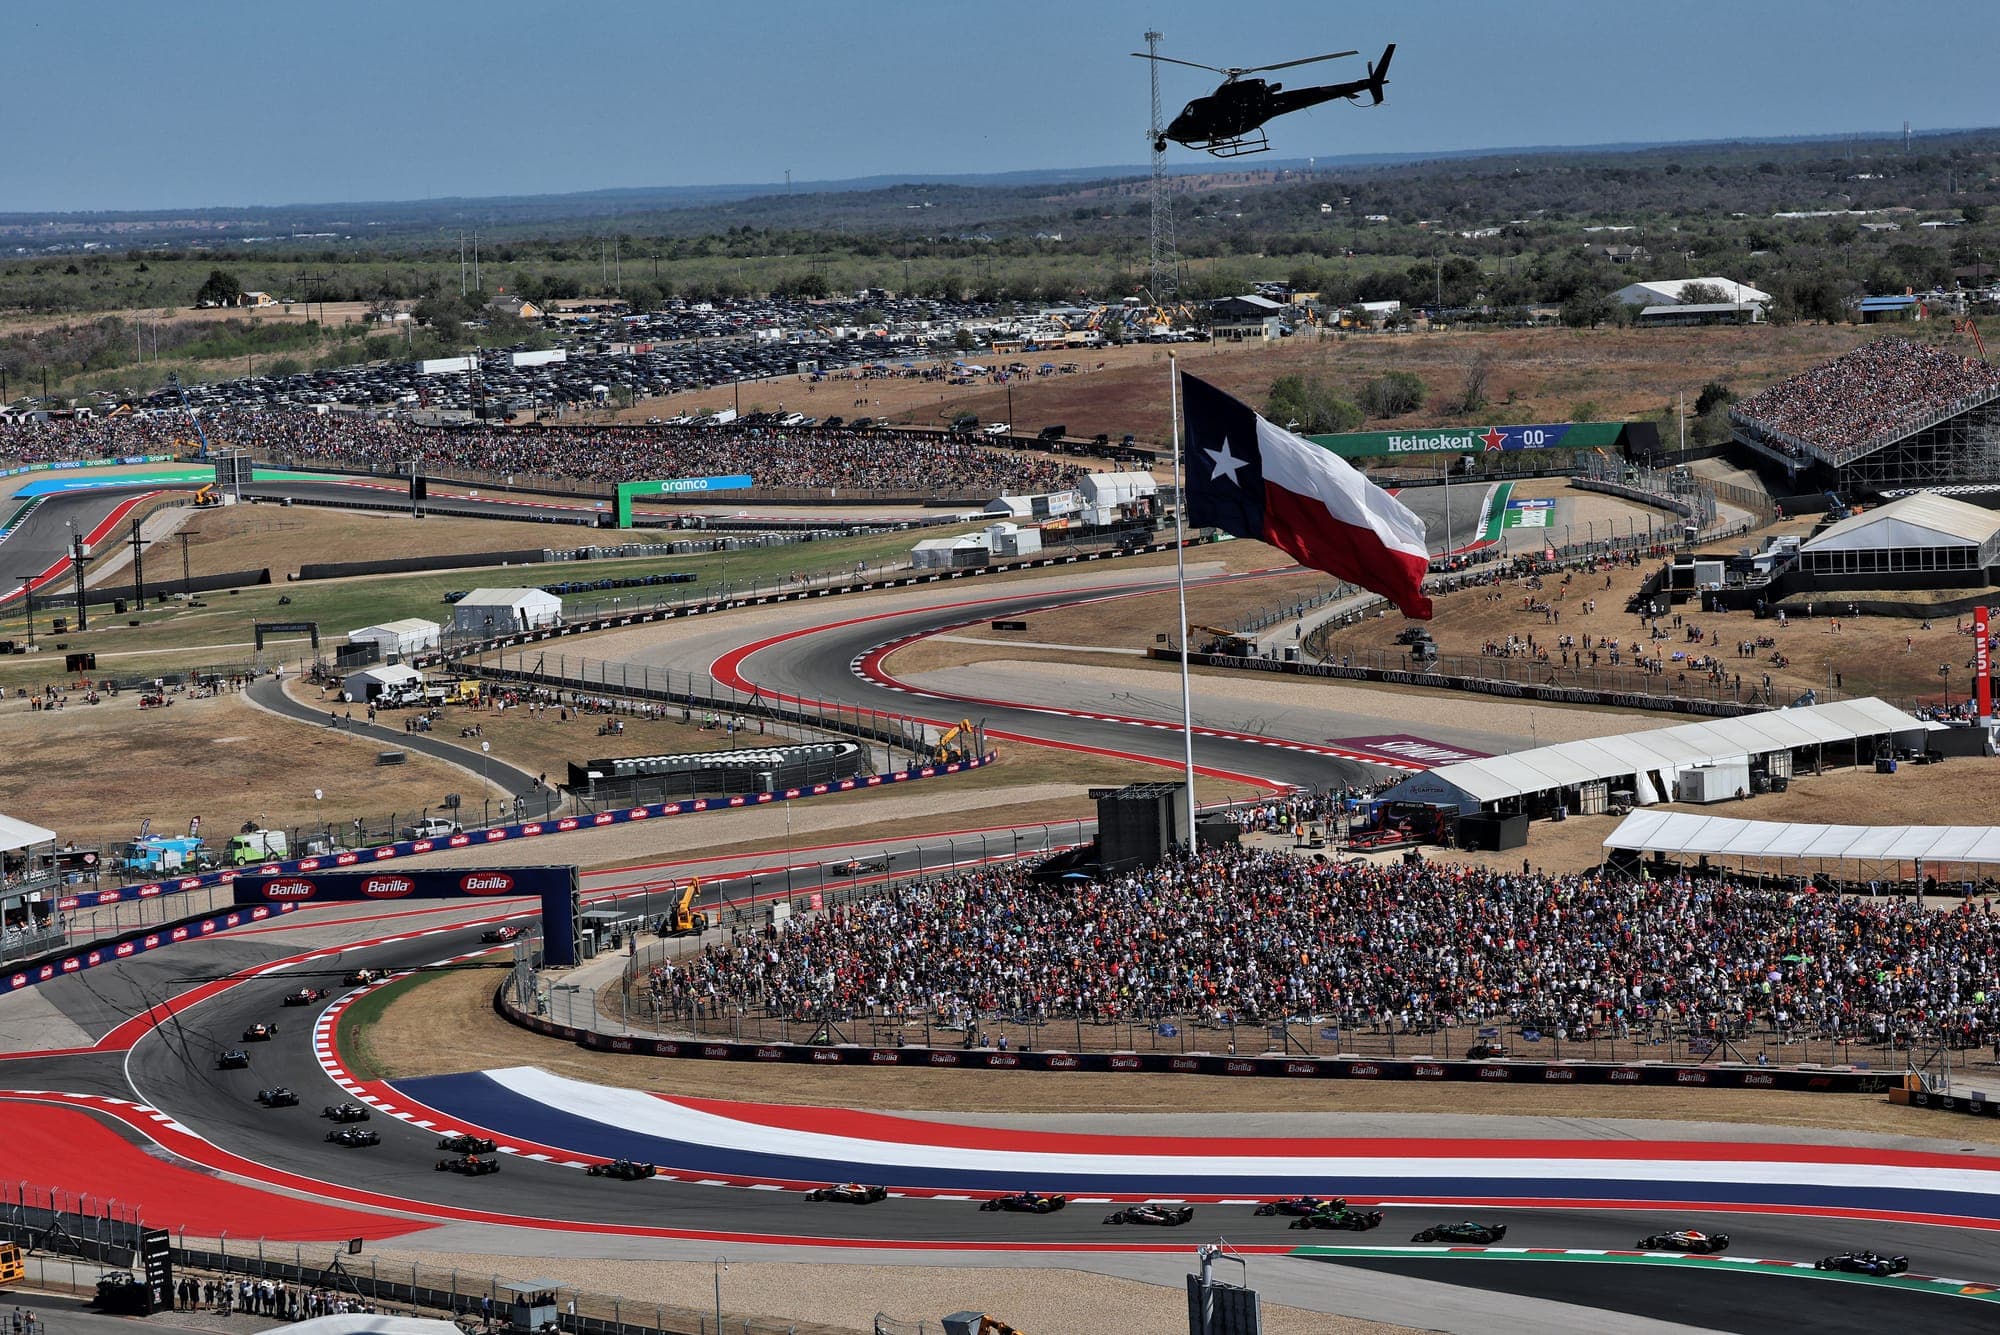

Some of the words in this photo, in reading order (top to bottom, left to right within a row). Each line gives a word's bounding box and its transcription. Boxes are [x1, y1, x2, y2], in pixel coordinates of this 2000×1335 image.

[1523, 430, 1544, 445] 0.0
[1388, 435, 1473, 451] Heineken
[661, 480, 707, 491] aramco
[1209, 654, 1240, 668] QATAR
[1242, 657, 1282, 672] AIRWAYS
[1297, 664, 1328, 677] QATAR
[1329, 667, 1368, 680] AIRWAYS
[1382, 671, 1412, 684] QATAR
[1413, 674, 1450, 687] AIRWAYS
[1463, 680, 1489, 692] QATAR
[1490, 683, 1523, 697] AIRWAYS
[1537, 688, 1564, 701] QATAR
[1566, 692, 1600, 703] AIRWAYS
[1612, 695, 1640, 707] QATAR
[1642, 698, 1674, 711] AIRWAYS
[368, 880, 408, 893] Barilla
[466, 877, 507, 889] Barilla
[269, 883, 309, 895] Barilla
[657, 1043, 677, 1053] Barilla
[705, 1047, 728, 1057] Barilla
[758, 1048, 782, 1058] Barilla
[814, 1051, 838, 1061] Barilla
[873, 1052, 898, 1062] Barilla
[931, 1054, 956, 1063] Barilla
[990, 1056, 1016, 1065] Barilla
[1051, 1057, 1077, 1067] Barilla
[1112, 1058, 1138, 1068] Barilla
[1173, 1060, 1197, 1069] Barilla
[1228, 1062, 1252, 1072] Barilla
[1288, 1064, 1314, 1073] Barilla
[1352, 1065, 1378, 1075] Barilla
[1416, 1067, 1443, 1076] Barilla
[1481, 1068, 1508, 1078] Barilla
[1546, 1070, 1572, 1079] Barilla
[1611, 1070, 1638, 1080] Barilla
[1678, 1072, 1706, 1082] Barilla
[1745, 1074, 1772, 1084] Barilla
